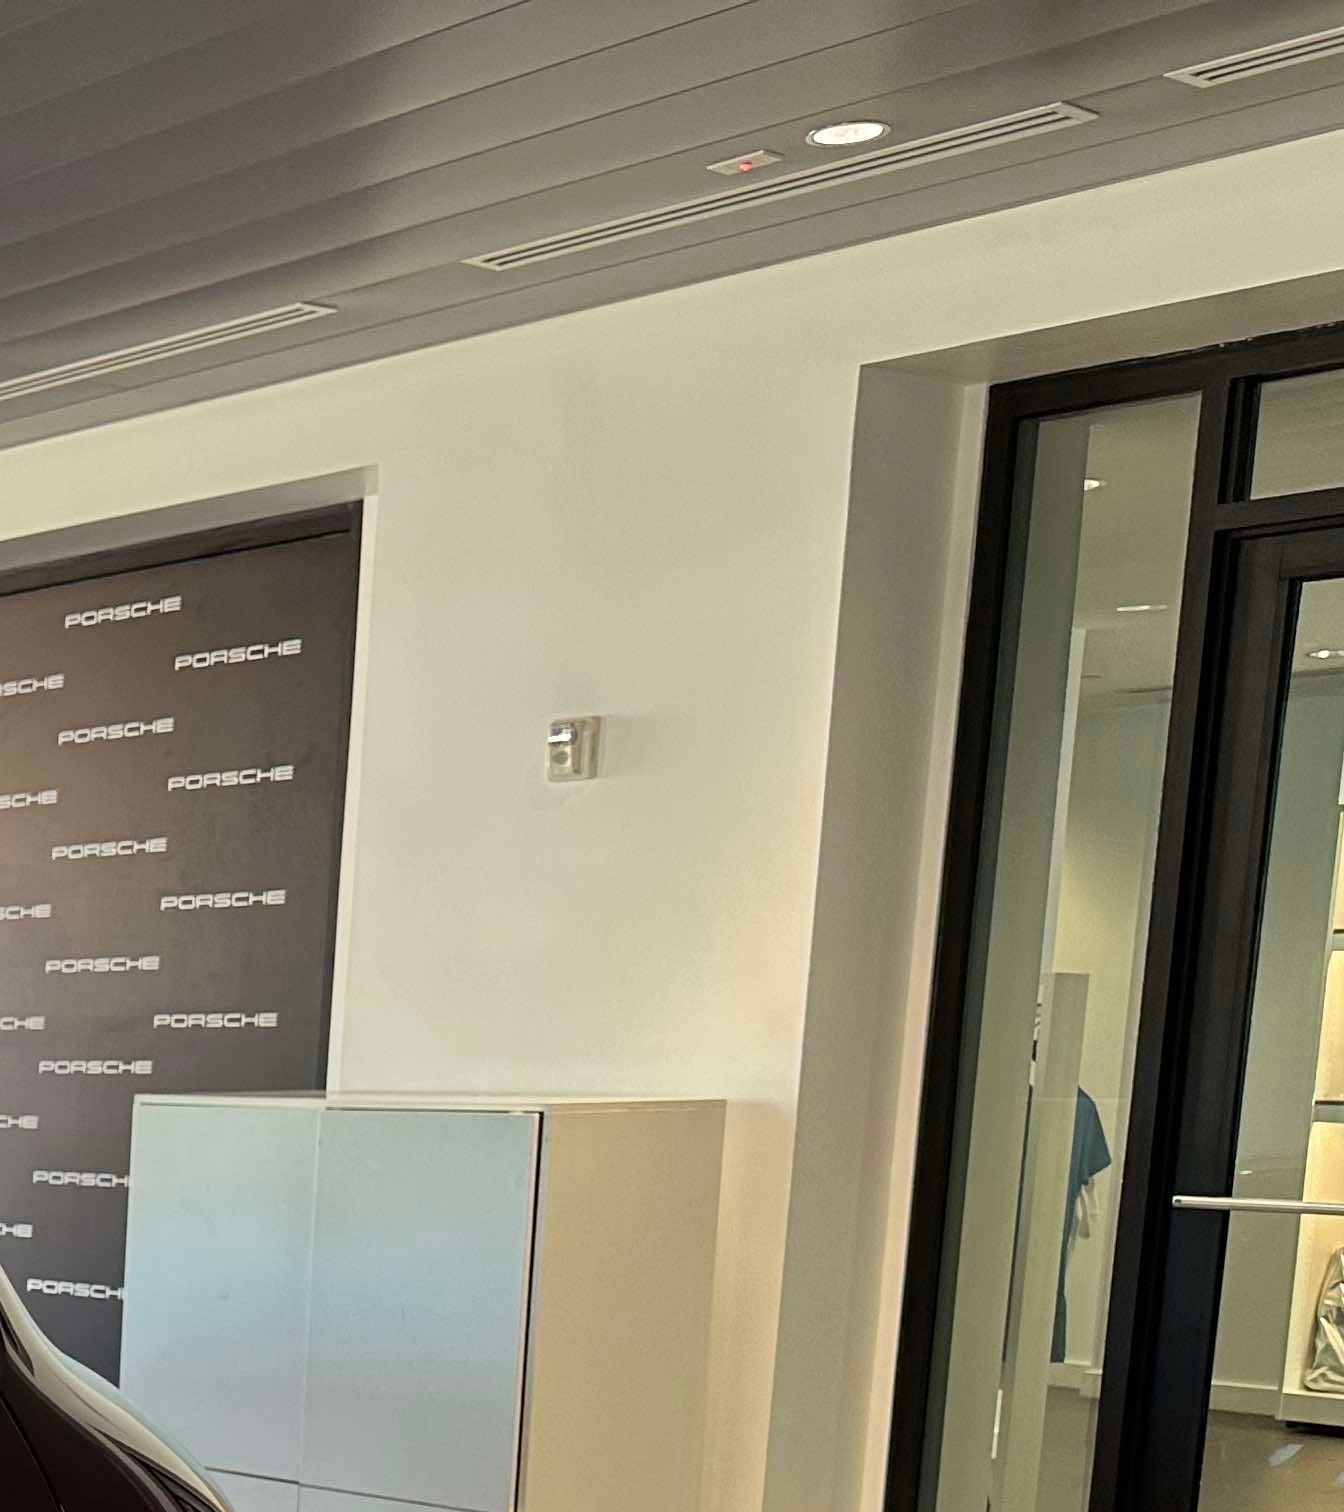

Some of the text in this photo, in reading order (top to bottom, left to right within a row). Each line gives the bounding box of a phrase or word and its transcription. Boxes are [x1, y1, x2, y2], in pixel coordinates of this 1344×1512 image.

[65, 596, 182, 629] PORSCHE
[175, 639, 302, 671] PORSCHE
[58, 717, 174, 746] PORSCHE
[168, 765, 294, 791] PORSCHE
[52, 837, 167, 860] PORSCHE
[160, 889, 286, 911] PORSCHE
[45, 956, 160, 973] PORSCHE
[153, 1012, 278, 1028] PORSCHE
[39, 1060, 152, 1075] PORSCHE
[32, 1170, 129, 1187] PORSCH
[26, 1278, 126, 1299] PORSCH
